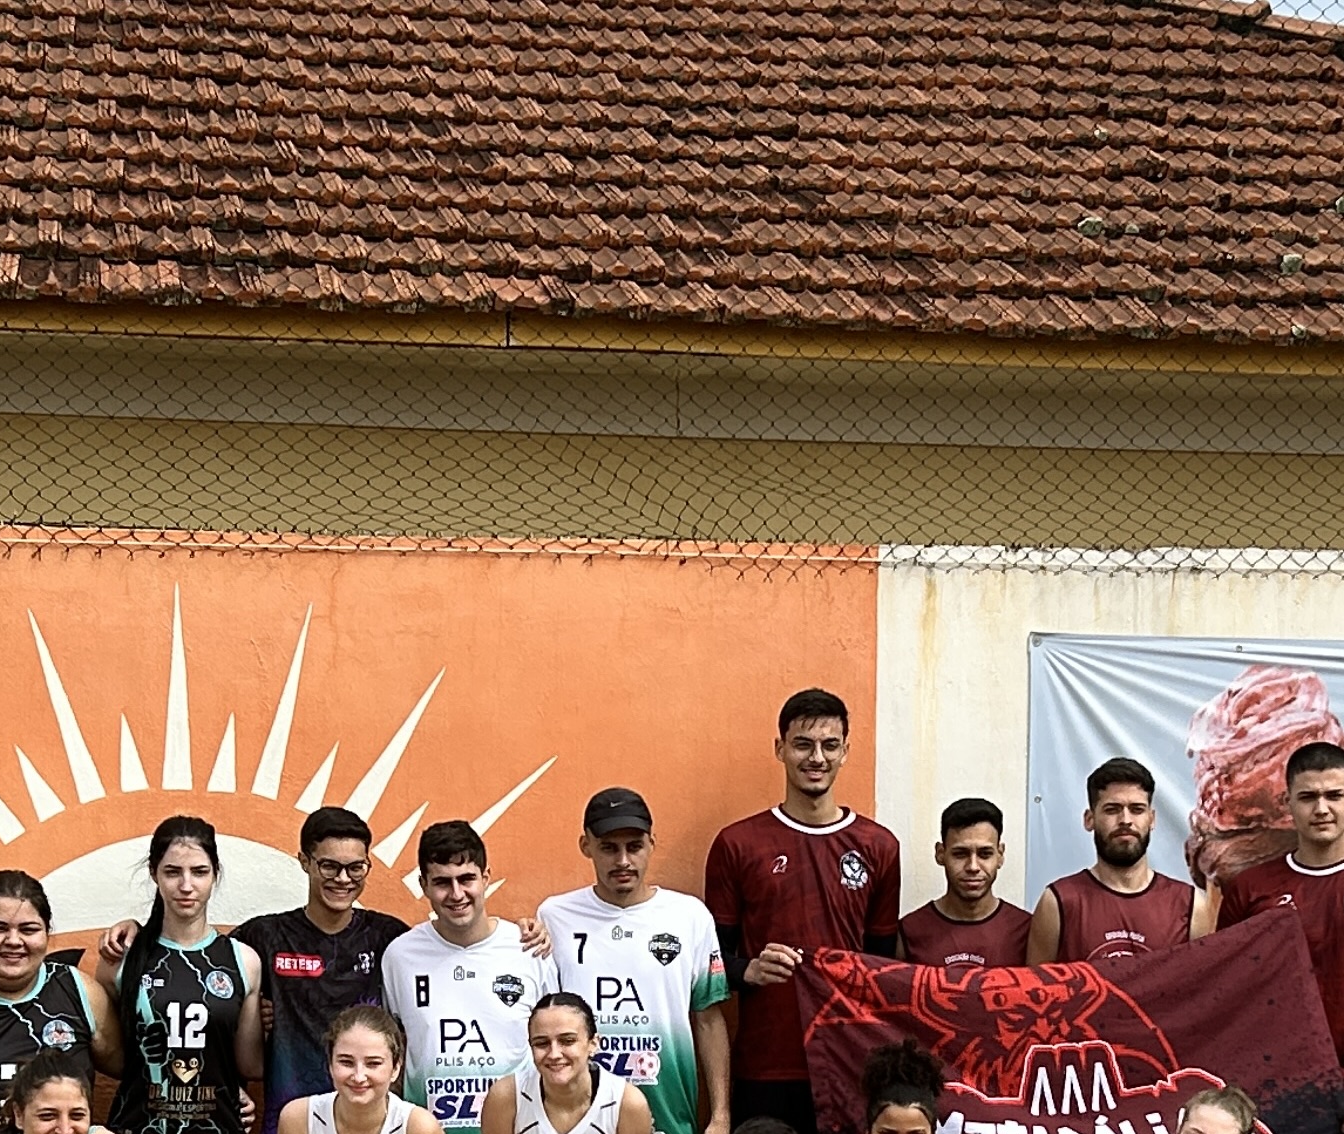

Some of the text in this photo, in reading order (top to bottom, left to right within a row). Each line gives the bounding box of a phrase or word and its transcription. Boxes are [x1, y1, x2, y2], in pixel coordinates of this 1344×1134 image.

[573, 932, 588, 965] 7
[415, 974, 430, 1008] 8
[596, 976, 645, 1012] PA
[166, 1001, 209, 1049] 12
[622, 1015, 650, 1027] AÇO
[439, 1018, 491, 1054] PA
[599, 1036, 660, 1051] ORTLINS
[436, 1056, 496, 1068] PLIS AÇO
[428, 1078, 497, 1095] SPORTLI
[432, 1094, 479, 1120] SL
